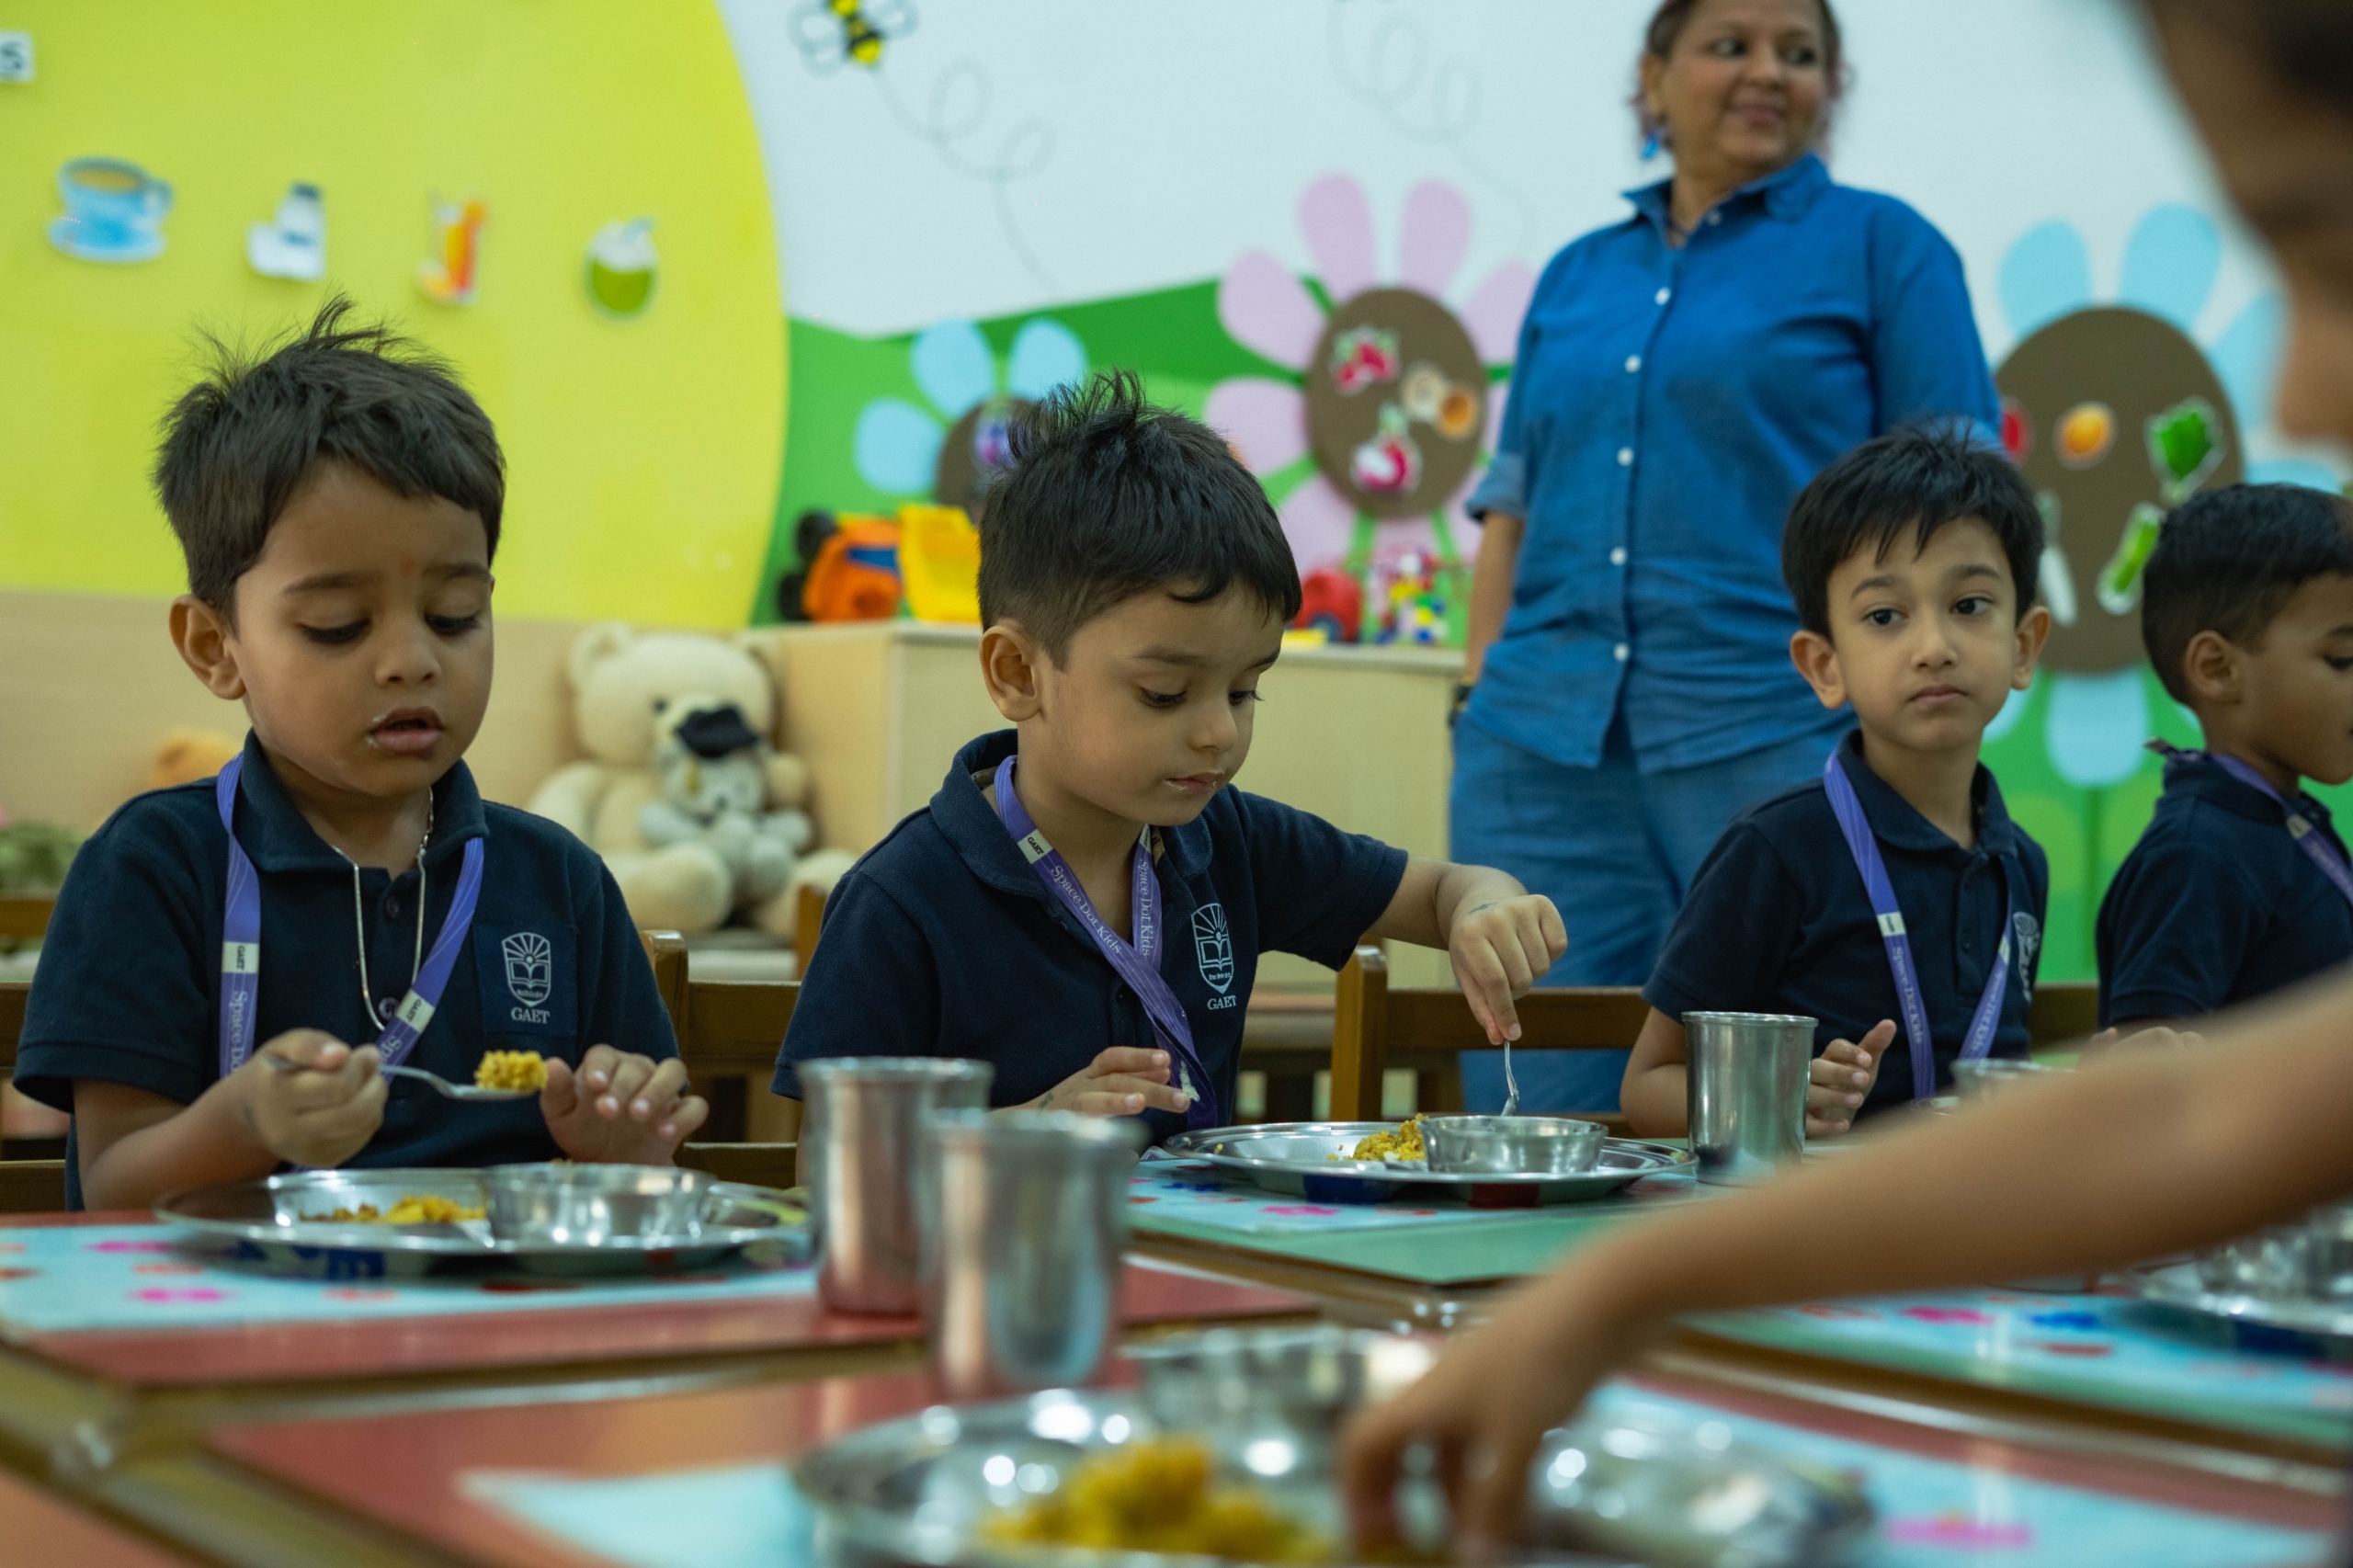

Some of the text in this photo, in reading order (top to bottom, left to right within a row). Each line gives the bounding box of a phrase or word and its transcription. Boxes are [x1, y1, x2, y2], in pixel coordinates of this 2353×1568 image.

[1027, 836, 1044, 856] GAET
[1051, 865, 1121, 954] Space Dot Kids
[1140, 897, 1153, 921] Dot
[1141, 926, 1154, 957] Kids
[1207, 994, 1237, 1010] GAET
[511, 1006, 551, 1024] GAET
[229, 991, 249, 1072] Space Do
